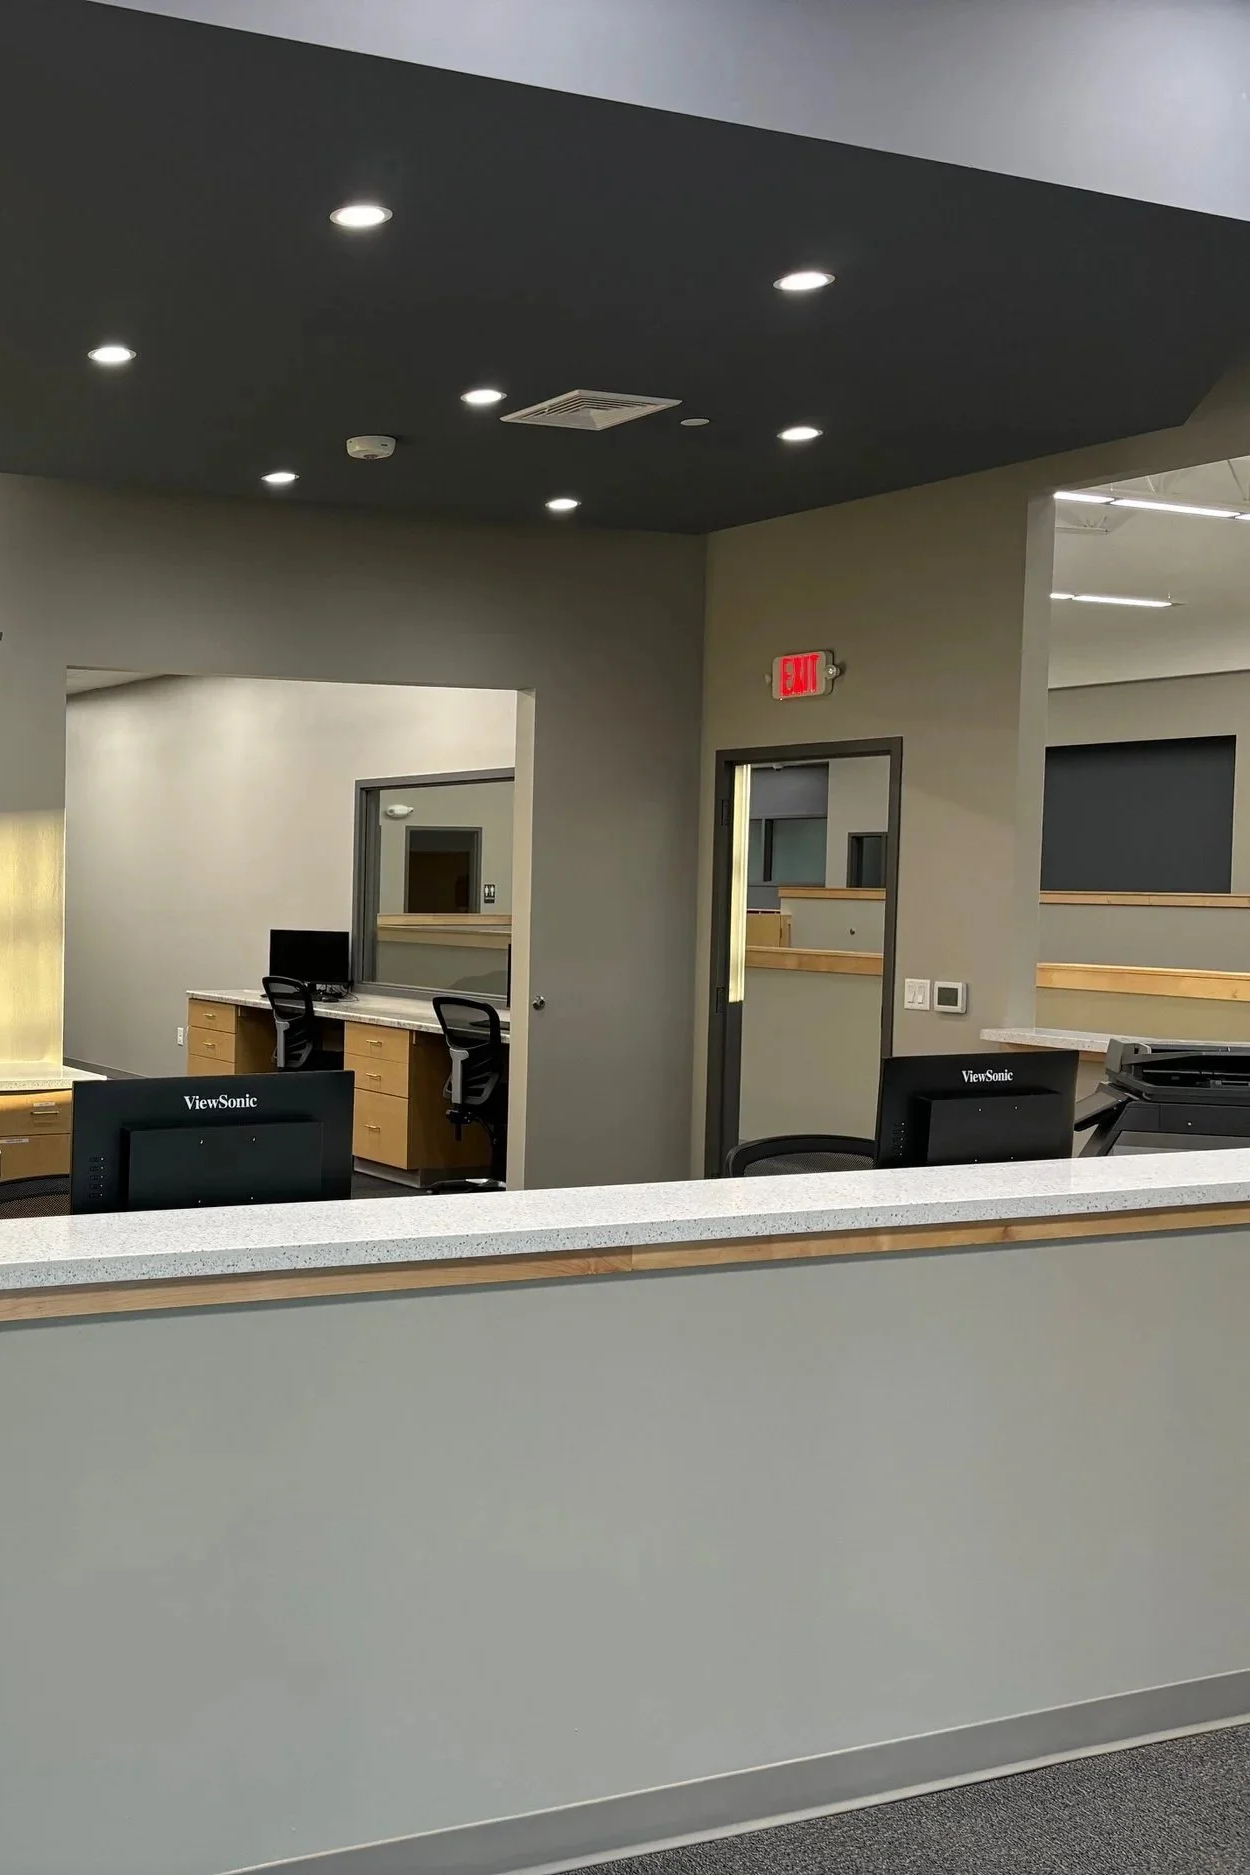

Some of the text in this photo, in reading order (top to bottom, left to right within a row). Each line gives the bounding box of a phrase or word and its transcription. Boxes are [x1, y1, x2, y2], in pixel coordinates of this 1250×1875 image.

[781, 654, 820, 697] EXIT
[961, 1068, 1014, 1083] ViewSonic
[183, 1093, 258, 1110] ViewSonic
